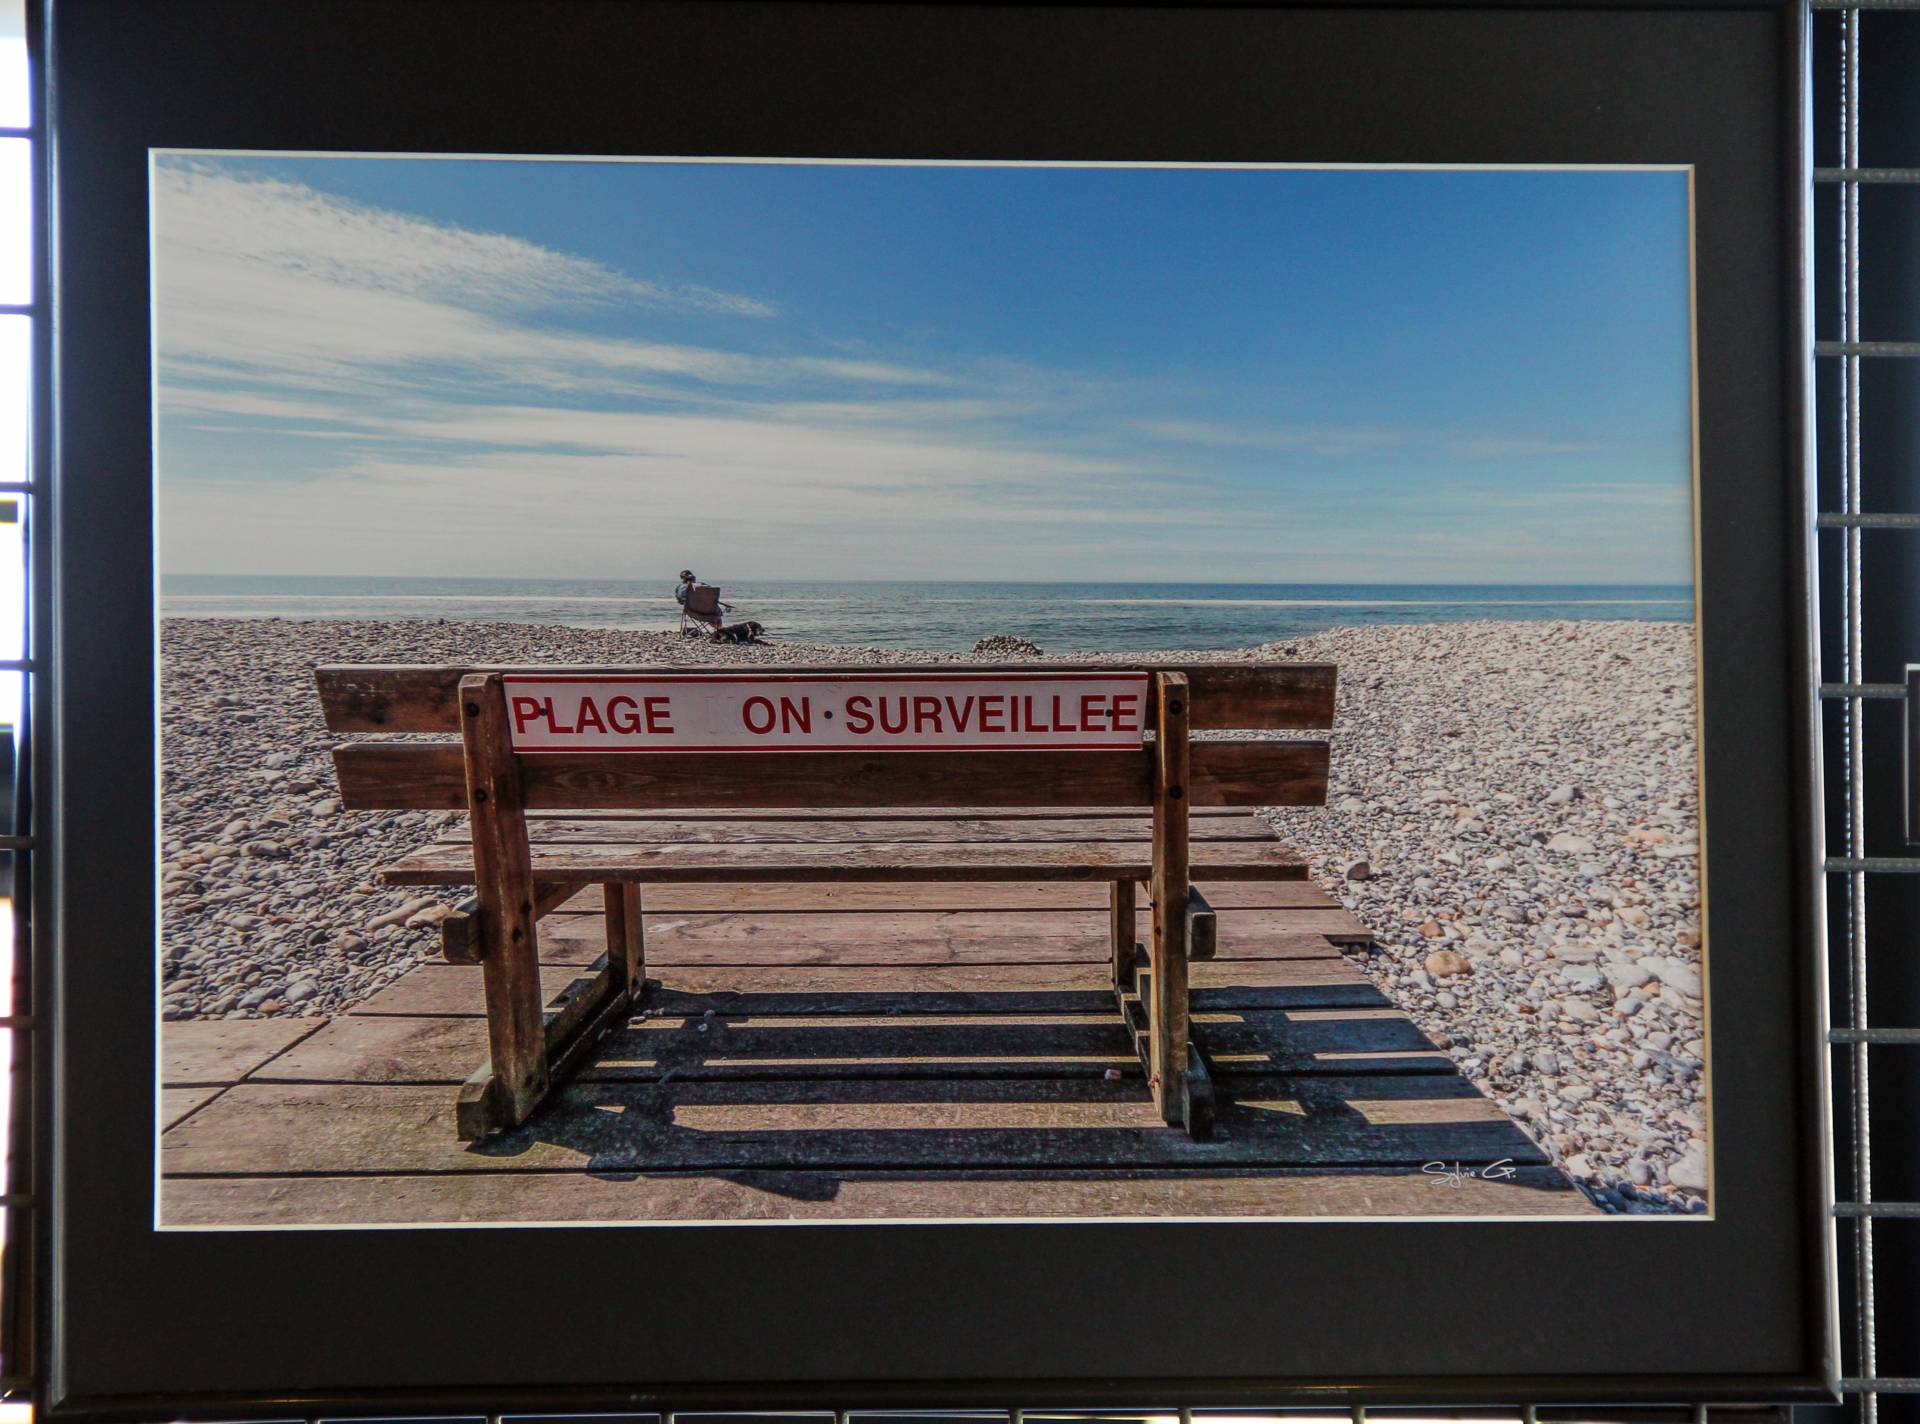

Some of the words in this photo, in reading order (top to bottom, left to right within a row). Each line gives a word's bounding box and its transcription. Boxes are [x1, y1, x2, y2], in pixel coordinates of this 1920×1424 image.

[511, 695, 675, 735] PLAGE
[741, 695, 812, 735] ON
[845, 694, 1138, 735] SURVEILLEE
[1421, 1161, 1476, 1188] Sylvie
